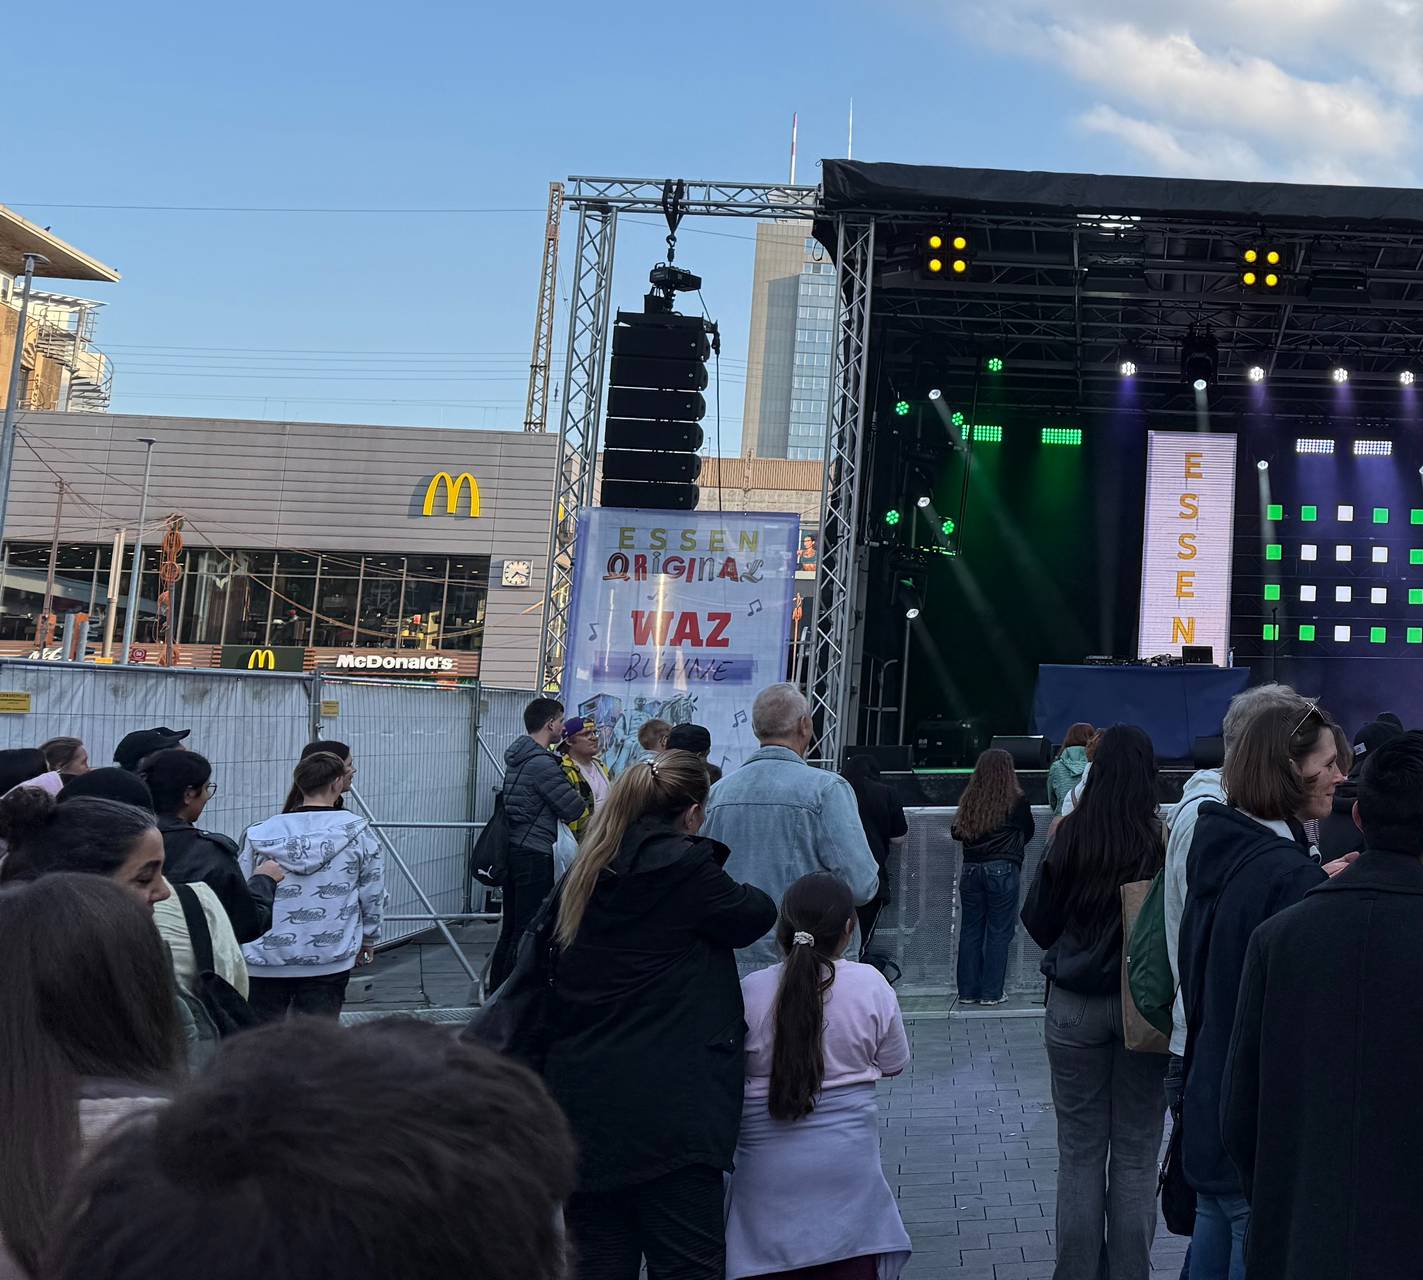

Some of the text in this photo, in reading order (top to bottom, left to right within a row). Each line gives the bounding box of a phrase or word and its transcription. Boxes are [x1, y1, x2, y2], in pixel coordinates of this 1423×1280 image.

[618, 527, 759, 552] ESSEN
[630, 610, 732, 648] WAZ
[336, 654, 453, 670] McDonald's
